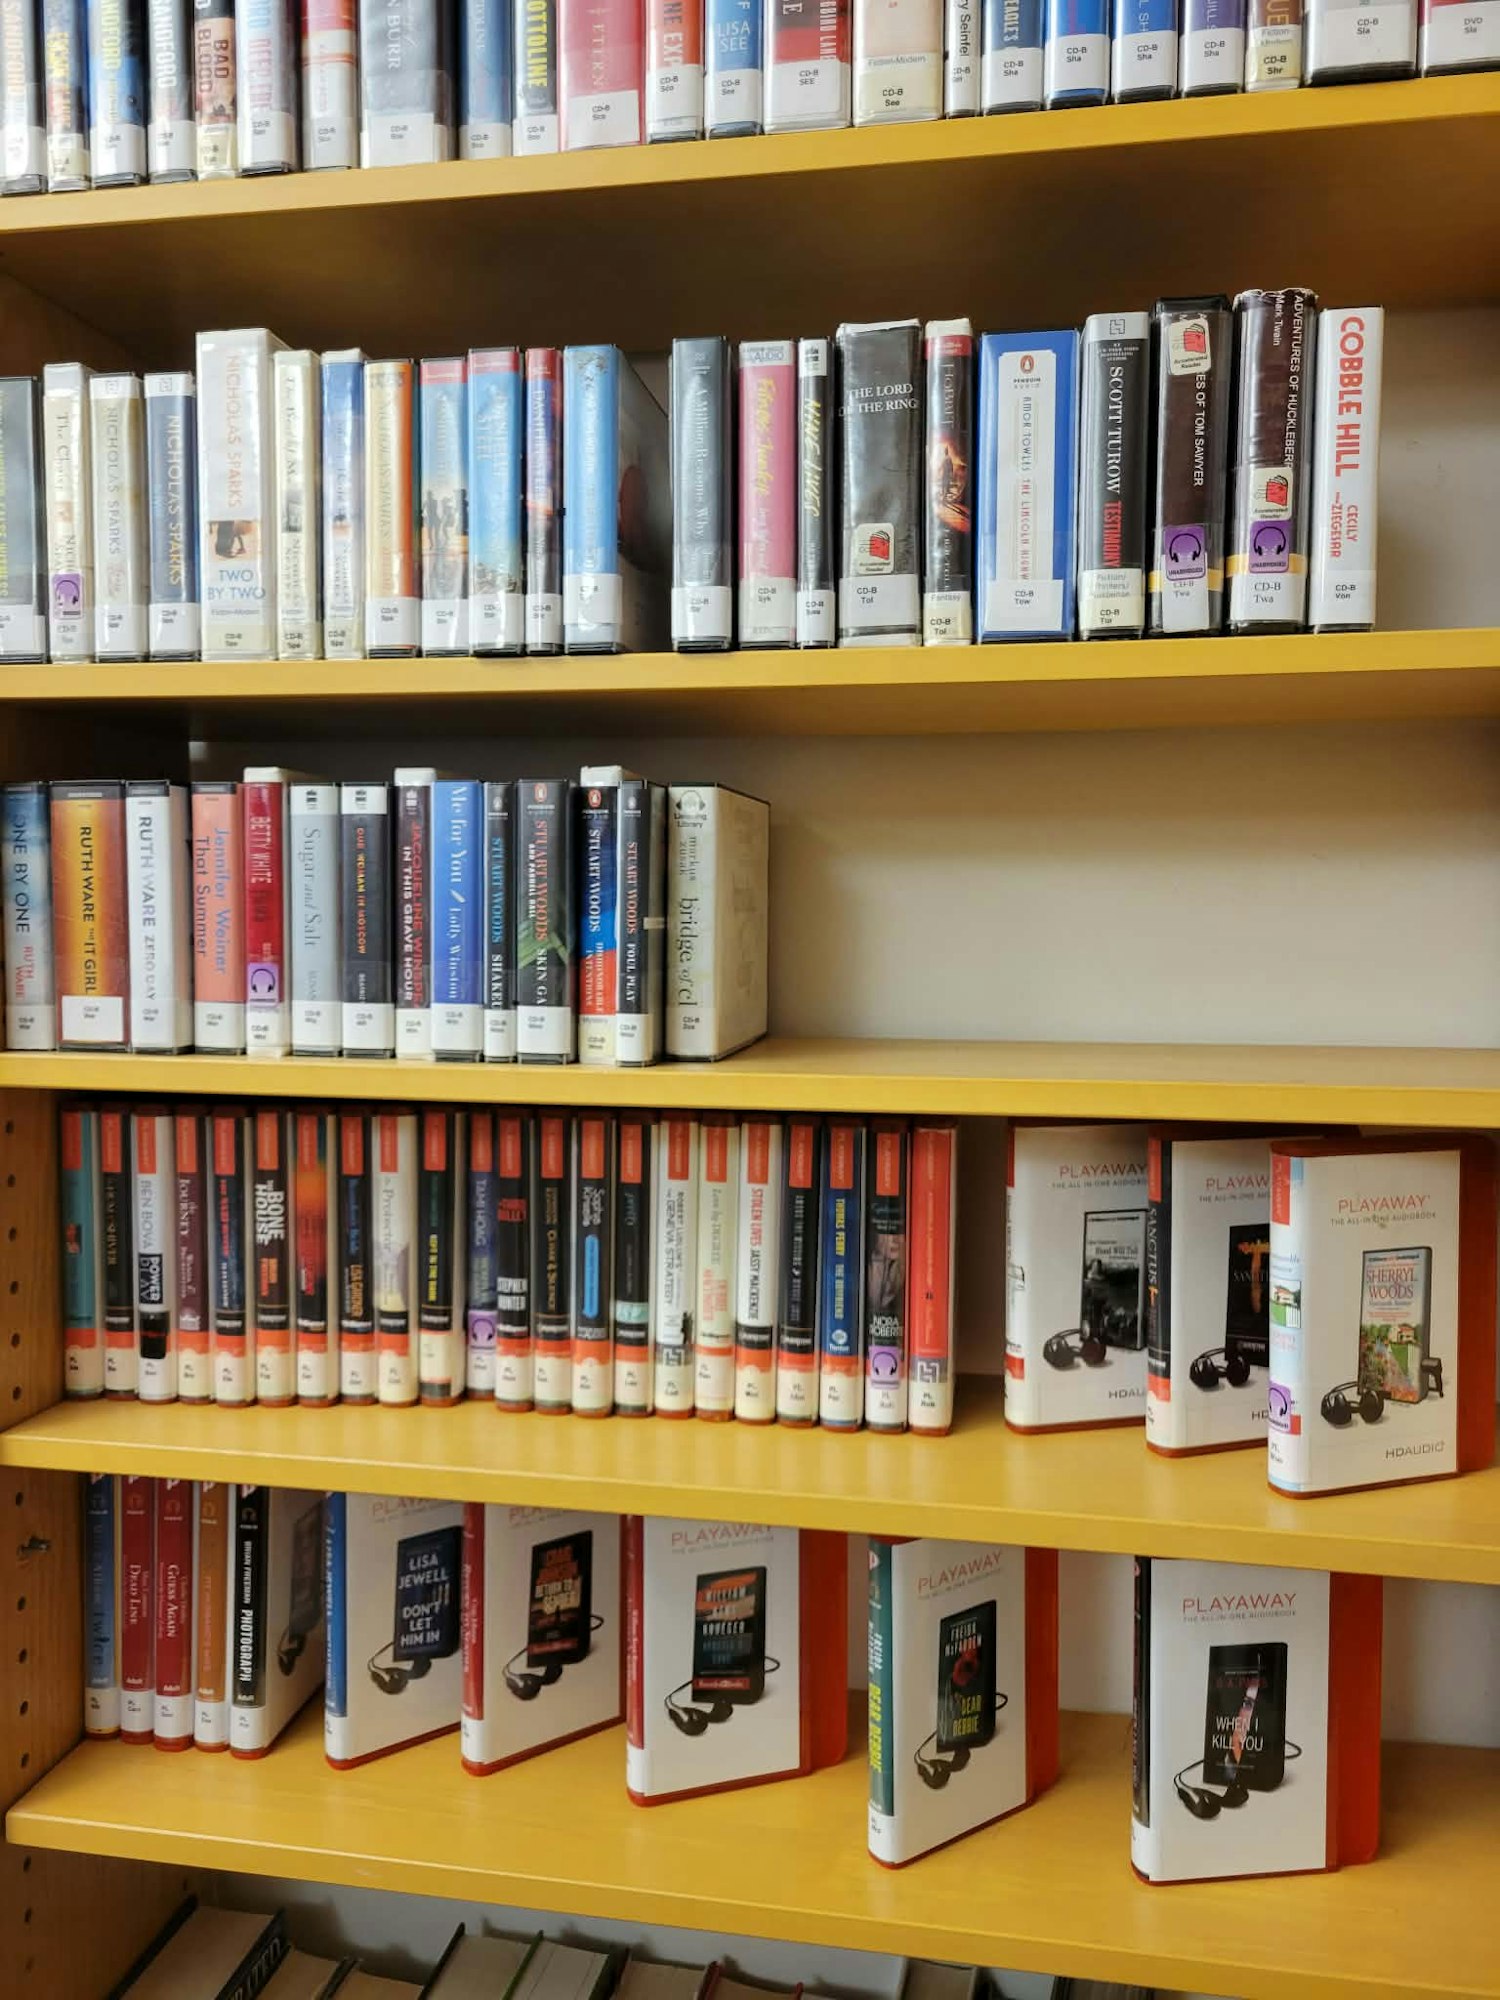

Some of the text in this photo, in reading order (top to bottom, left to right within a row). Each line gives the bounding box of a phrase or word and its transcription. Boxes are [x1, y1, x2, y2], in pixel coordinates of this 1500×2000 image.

[717, 21, 750, 37] LISA
[959, 14, 971, 57] Seinfel
[1356, 18, 1379, 26] CD-B
[1356, 27, 1371, 35] Sla
[1463, 17, 1484, 26] DVD
[1463, 26, 1478, 34] Sla
[387, 15, 401, 70] BURR
[719, 36, 749, 51] SEE
[1066, 46, 1087, 55] CD-B
[1137, 44, 1158, 53] CD-B
[1137, 53, 1153, 61] Sha
[1204, 40, 1226, 49] CD-B
[1204, 49, 1220, 58] Sha
[197, 28, 213, 94] BLOOD
[212, 39, 229, 79] BAD
[799, 69, 819, 77] CD-B
[1003, 60, 1024, 69] CD-B
[1066, 55, 1082, 63] Sha
[1263, 55, 1287, 64] CD-B
[1267, 67, 1284, 75] Shr
[660, 76, 679, 84] CD-B
[721, 79, 740, 87] CD-B
[799, 77, 816, 85] SEE
[882, 88, 903, 97] CD-B
[885, 99, 901, 107] See
[1272, 293, 1285, 347] Mark Twain
[1288, 295, 1304, 392] ADVENTURES OF
[847, 383, 914, 399] THE LORD
[858, 398, 918, 413] THE RING
[1107, 366, 1124, 423] SCOTT
[1335, 315, 1365, 477] COBBLE HILL
[227, 355, 243, 508] NICHOLAS SPARKS
[803, 398, 822, 456] NINE
[1192, 392, 1206, 487] OF TOM SAWYER
[106, 406, 118, 494] NICHOLAS
[1105, 427, 1124, 494] TUROW
[1019, 396, 1033, 545] AMOR TOWLES LINCOLN
[166, 415, 183, 586] NICHOLAS SPARKS
[803, 462, 822, 518] LIVES
[106, 501, 119, 556] SPARKS
[1103, 500, 1122, 568] TESTIMONY
[1346, 504, 1359, 543] CECILY
[218, 568, 255, 581] TWO
[856, 586, 877, 595] CD-B
[1254, 582, 1281, 592] CD-B
[1335, 584, 1356, 592] CD-B
[207, 586, 266, 600] BY TWO
[930, 592, 961, 602] Fantasy
[1014, 590, 1034, 598] CD-B
[1254, 593, 1274, 603] Twa
[930, 617, 951, 626] CD-B
[1100, 609, 1119, 617] CD-B
[934, 627, 947, 636] Tol
[249, 815, 273, 885] BETTY WHITE
[677, 840, 688, 877] zusak
[687, 836, 698, 883] markus
[138, 815, 157, 928] RUTH WARE
[357, 853, 366, 894] WOMAN
[411, 822, 423, 931] JACQUELINE
[450, 849, 468, 884] You
[588, 828, 601, 933] STUART WOODS
[13, 862, 31, 934] BY ONE
[196, 836, 210, 958] That Summer
[213, 827, 232, 975] Jennifer Weiner
[297, 827, 321, 947] Sugar Salt
[490, 836, 505, 945] STUART WOODS
[534, 820, 549, 983] STUART WOODS SKIN
[80, 826, 98, 994] RUTH WARE IT GIRL
[402, 846, 415, 1001] IN THIS GRAVE HOUR
[625, 841, 638, 1003] STUART WOODS FOUL PLAY
[676, 897, 700, 964] bridge
[1058, 1163, 1146, 1179] PLAYAWAY
[177, 1178, 192, 1236] JOURNEY
[475, 1178, 487, 1208] TAMI
[677, 1191, 685, 1226] ROBERT
[1338, 1195, 1428, 1213] PLAYAWAY
[139, 1179, 154, 1250] BEN BOVA
[254, 1183, 270, 1246] HOUSE
[271, 1190, 286, 1241] BONE
[380, 1188, 395, 1253] Protector
[475, 1209, 488, 1247] HOAG
[1331, 1211, 1437, 1227] THE AUDIOBOOK
[664, 1198, 674, 1305] GENEVA STRATEGY
[747, 1188, 764, 1321] STOLEN LIVES JASSY MACKENZIE
[152, 1256, 164, 1302] POWER
[350, 1264, 363, 1281] LISA
[1366, 1266, 1418, 1284] SHERRYL
[350, 1281, 364, 1317] GARDNER
[1368, 1284, 1414, 1300] WOODS
[872, 1316, 899, 1328] NORA
[1385, 1443, 1445, 1460] HDAUDIO
[408, 1554, 439, 1571] LISA
[917, 1550, 1003, 1595] PLAYAWAY
[129, 1564, 141, 1625] DEAD LINE
[398, 1569, 448, 1590] JEWELL
[165, 1564, 180, 1638] GUESS AGAIN
[402, 1600, 441, 1619] DON'T
[1182, 1593, 1297, 1614] PLAYAWAY
[400, 1629, 440, 1648] HIM IN
[409, 1617, 432, 1632] LET
[238, 1608, 254, 1682] PHOTOGRAPH
[959, 1694, 982, 1715] DEAR
[869, 1682, 882, 1775] DEAR DEBBIE
[952, 1714, 980, 1737] DEBBIE
[1215, 1715, 1259, 1732] WHEN I
[1211, 1735, 1264, 1752] KILL YOU
